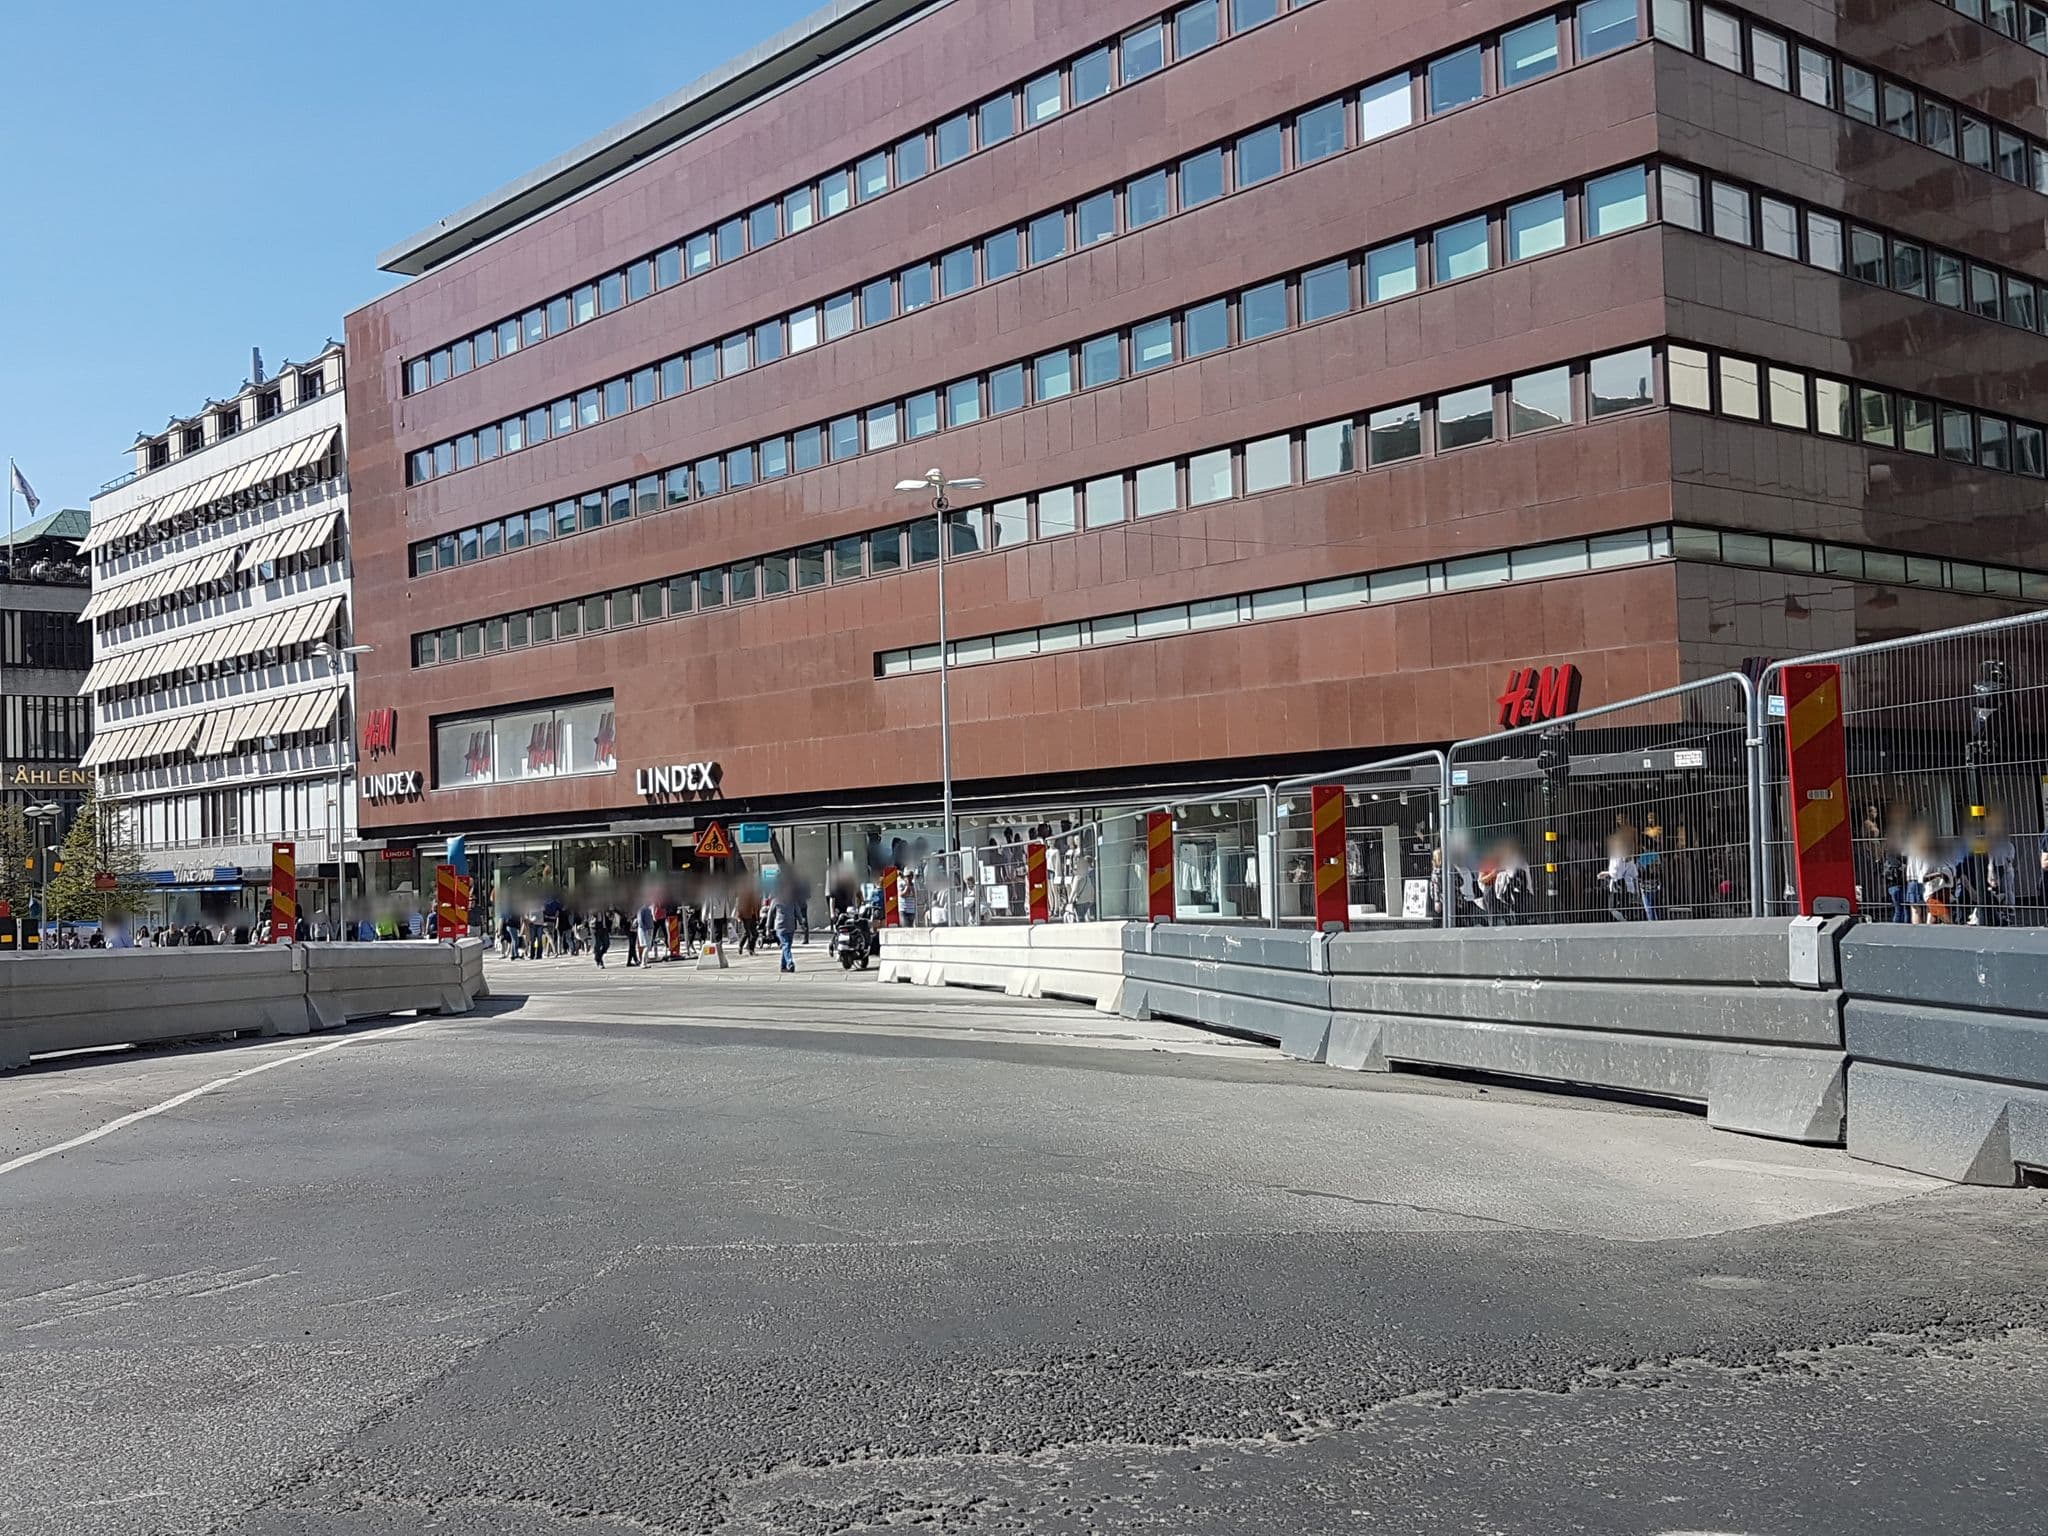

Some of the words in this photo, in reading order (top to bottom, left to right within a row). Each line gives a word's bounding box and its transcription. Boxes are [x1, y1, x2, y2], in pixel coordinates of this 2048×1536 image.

[1497, 662, 1572, 726] H&M
[14, 764, 96, 784] ÅHLÉNS
[362, 770, 416, 798] LINDEX
[636, 761, 714, 795] LINDEX
[385, 850, 411, 858] LINDEX
